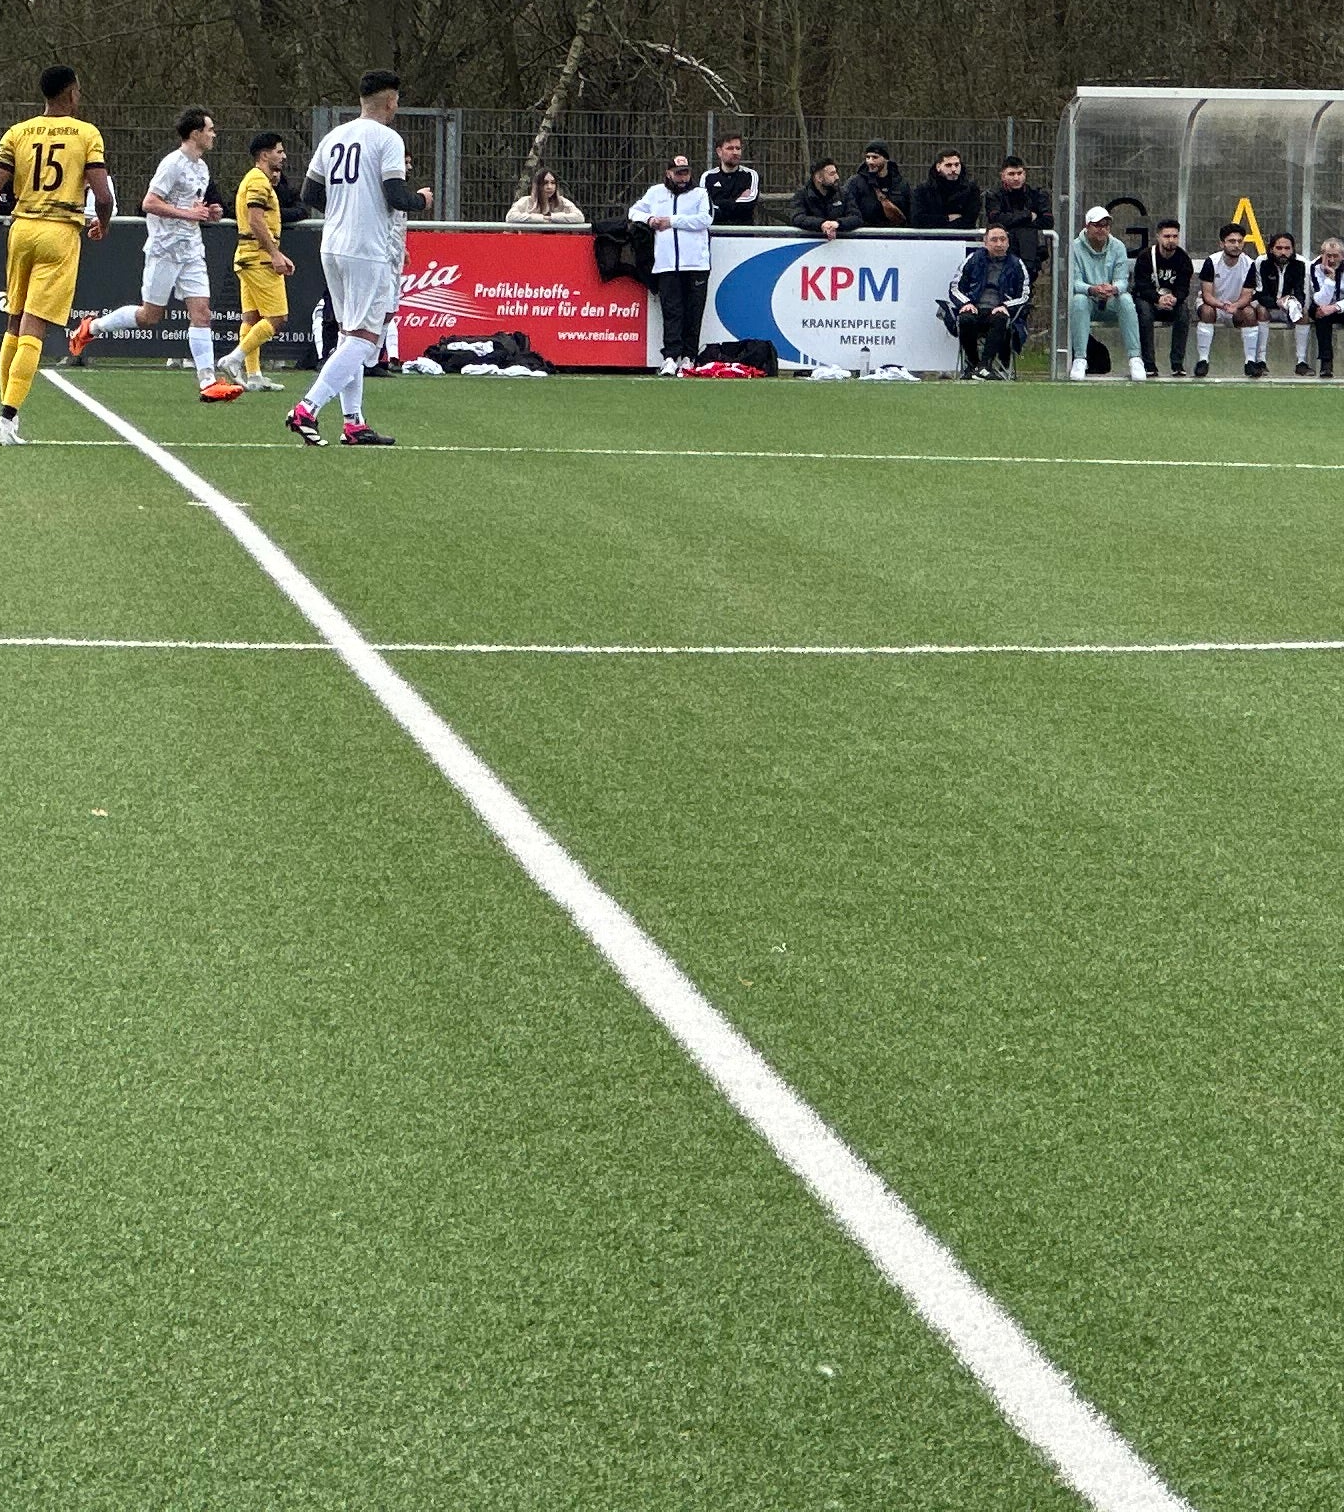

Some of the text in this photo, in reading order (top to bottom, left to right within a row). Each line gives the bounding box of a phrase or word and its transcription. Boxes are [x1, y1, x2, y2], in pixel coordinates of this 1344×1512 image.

[32, 142, 66, 192] 15
[330, 142, 361, 185] 20
[474, 283, 570, 300] Profiklebstoffe
[800, 265, 899, 302] KPM
[497, 302, 640, 318] nicht nur für den Profi
[404, 313, 429, 327] for
[429, 314, 457, 328] Life
[801, 318, 897, 329] KRANKENPFLEGE
[557, 329, 639, 341] www.renia.com
[839, 335, 896, 345] MERHEIM
